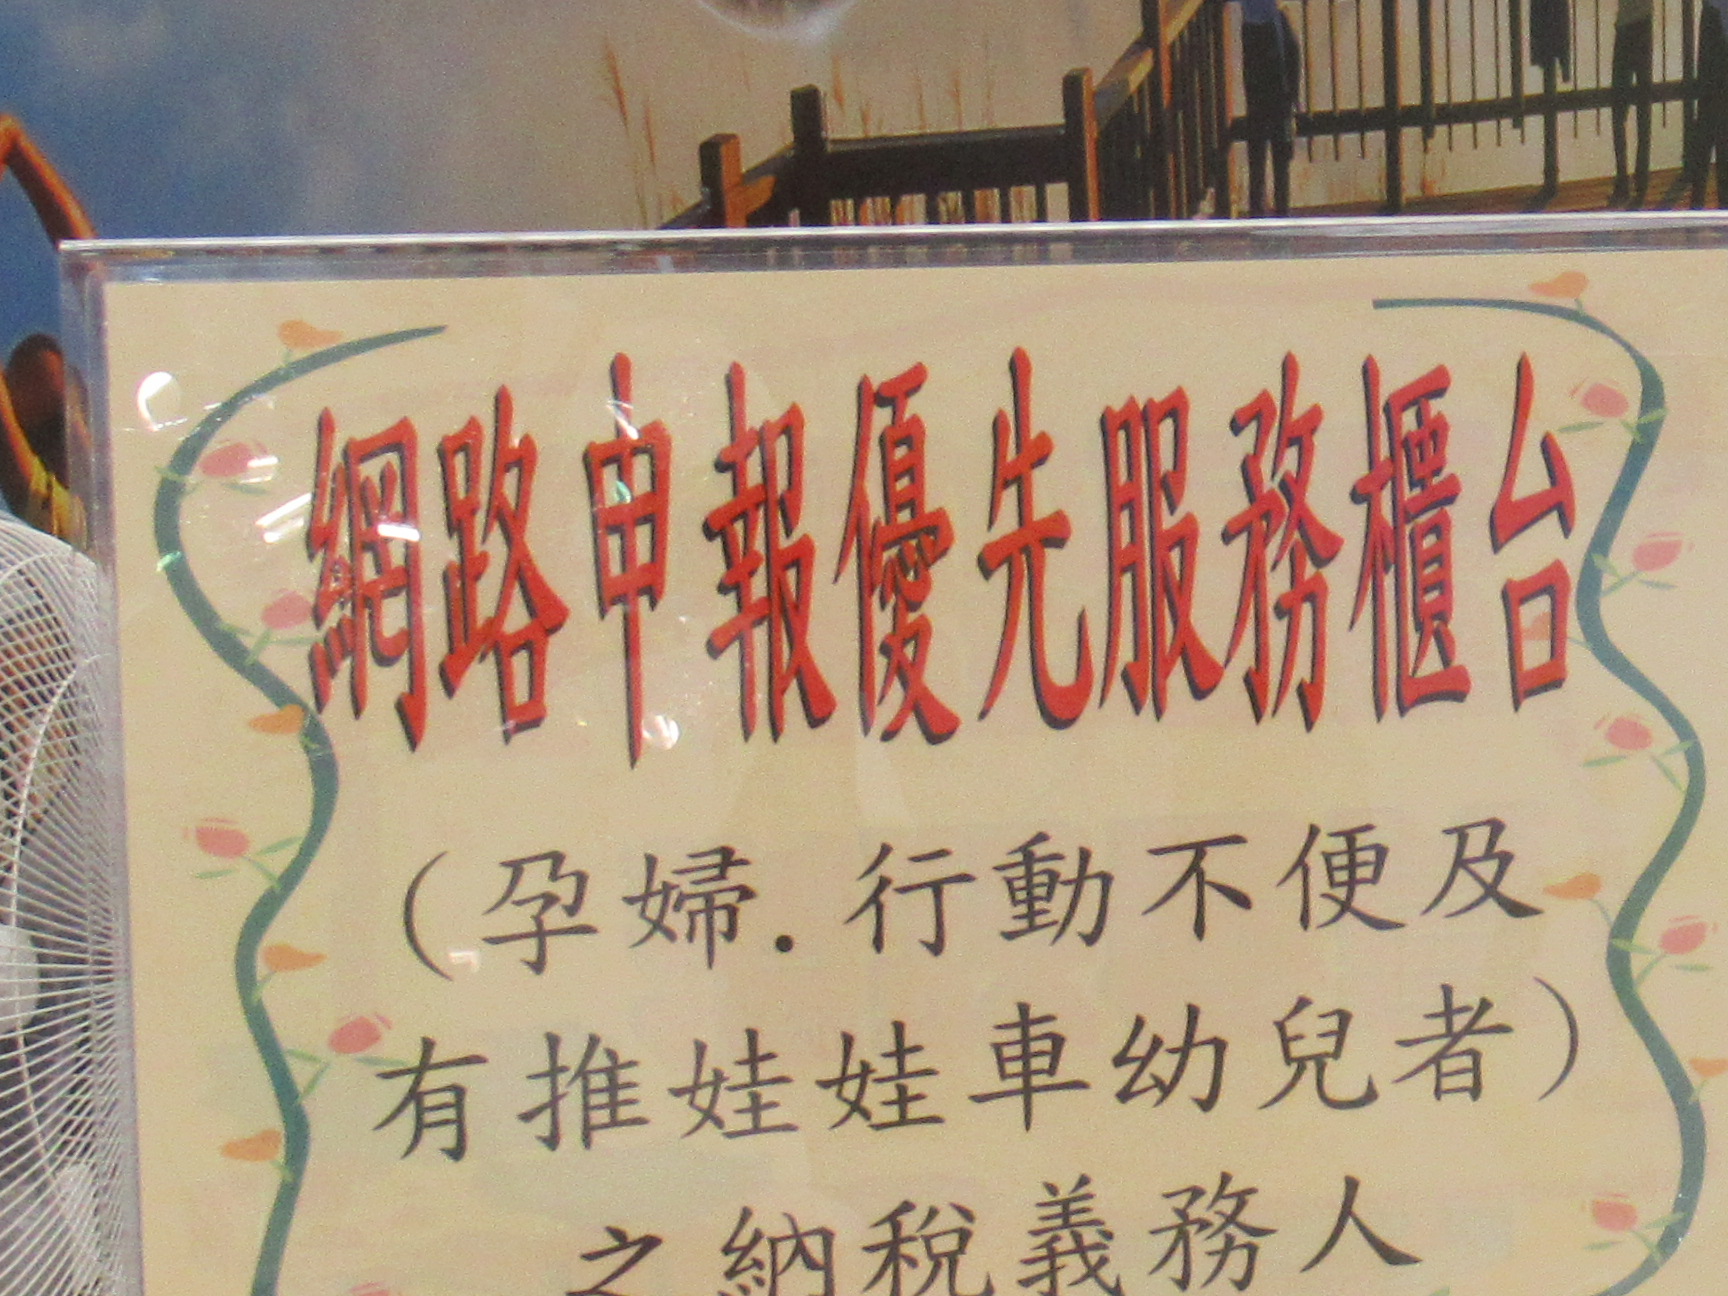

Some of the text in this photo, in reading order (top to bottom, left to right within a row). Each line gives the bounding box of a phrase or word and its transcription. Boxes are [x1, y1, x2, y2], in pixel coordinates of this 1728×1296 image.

[306, 345, 1578, 768] 網路申報優先服務櫃台
